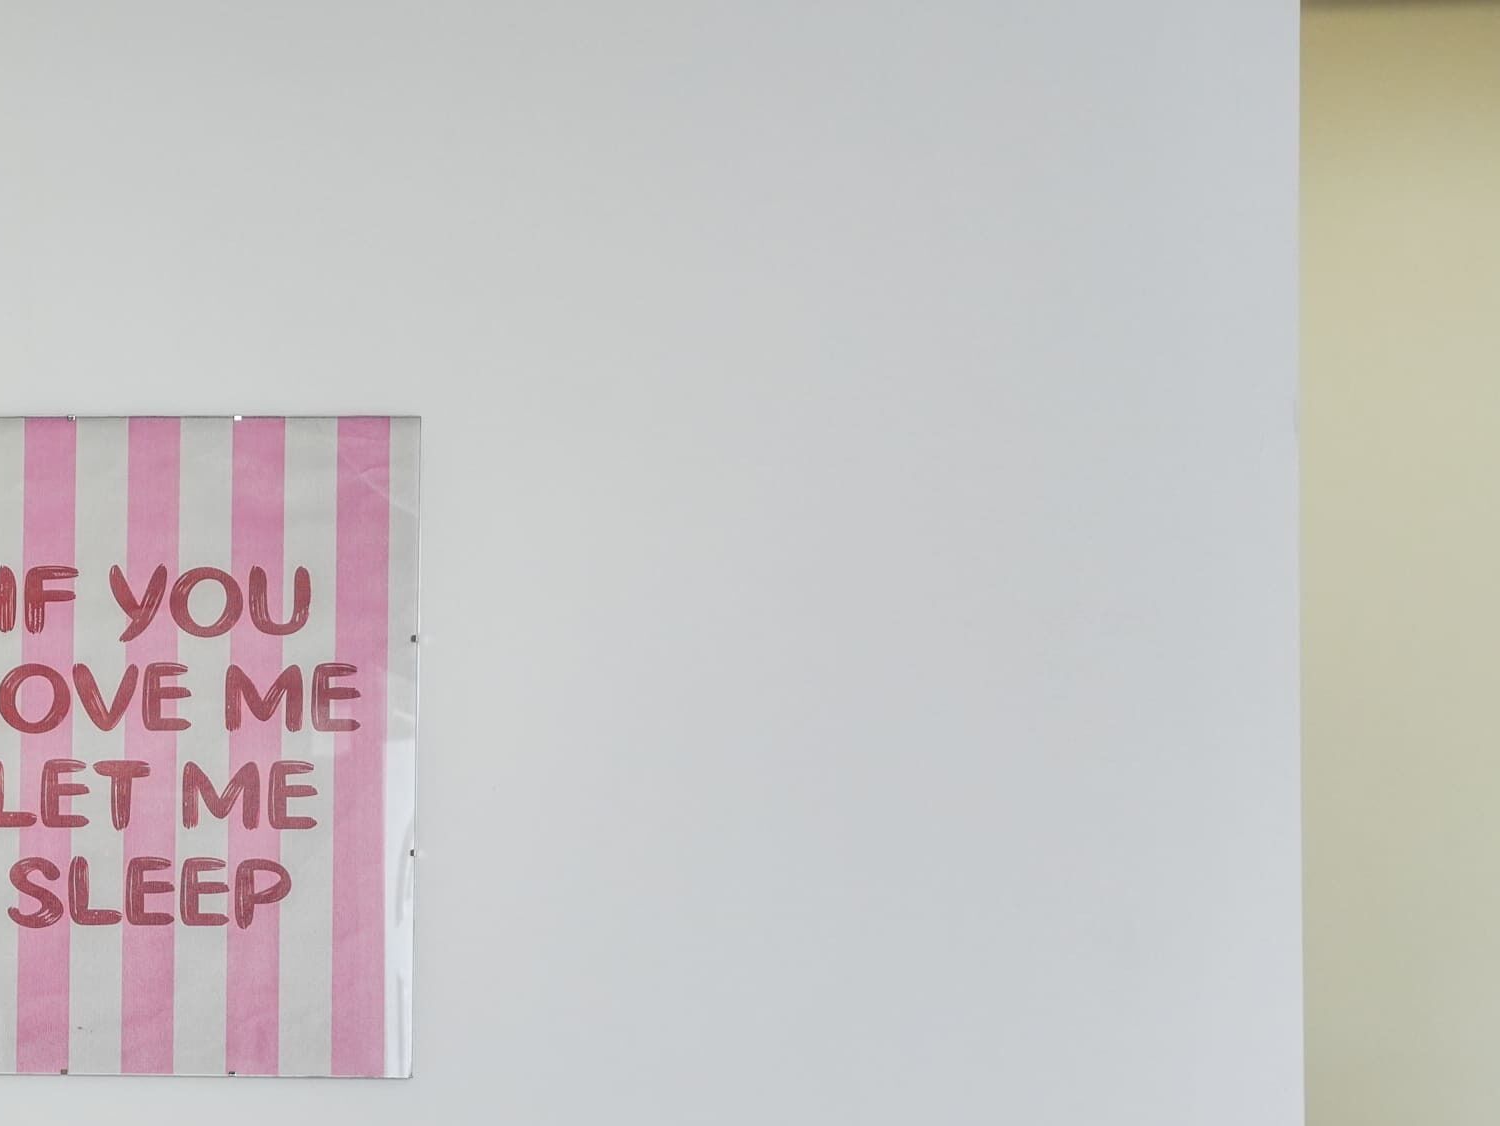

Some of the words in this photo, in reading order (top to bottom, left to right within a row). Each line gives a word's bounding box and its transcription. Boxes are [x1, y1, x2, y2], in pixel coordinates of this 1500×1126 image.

[108, 563, 312, 642] YOU
[224, 662, 362, 732] ME
[182, 760, 318, 831] ME
[7, 855, 293, 930] SLEEP
